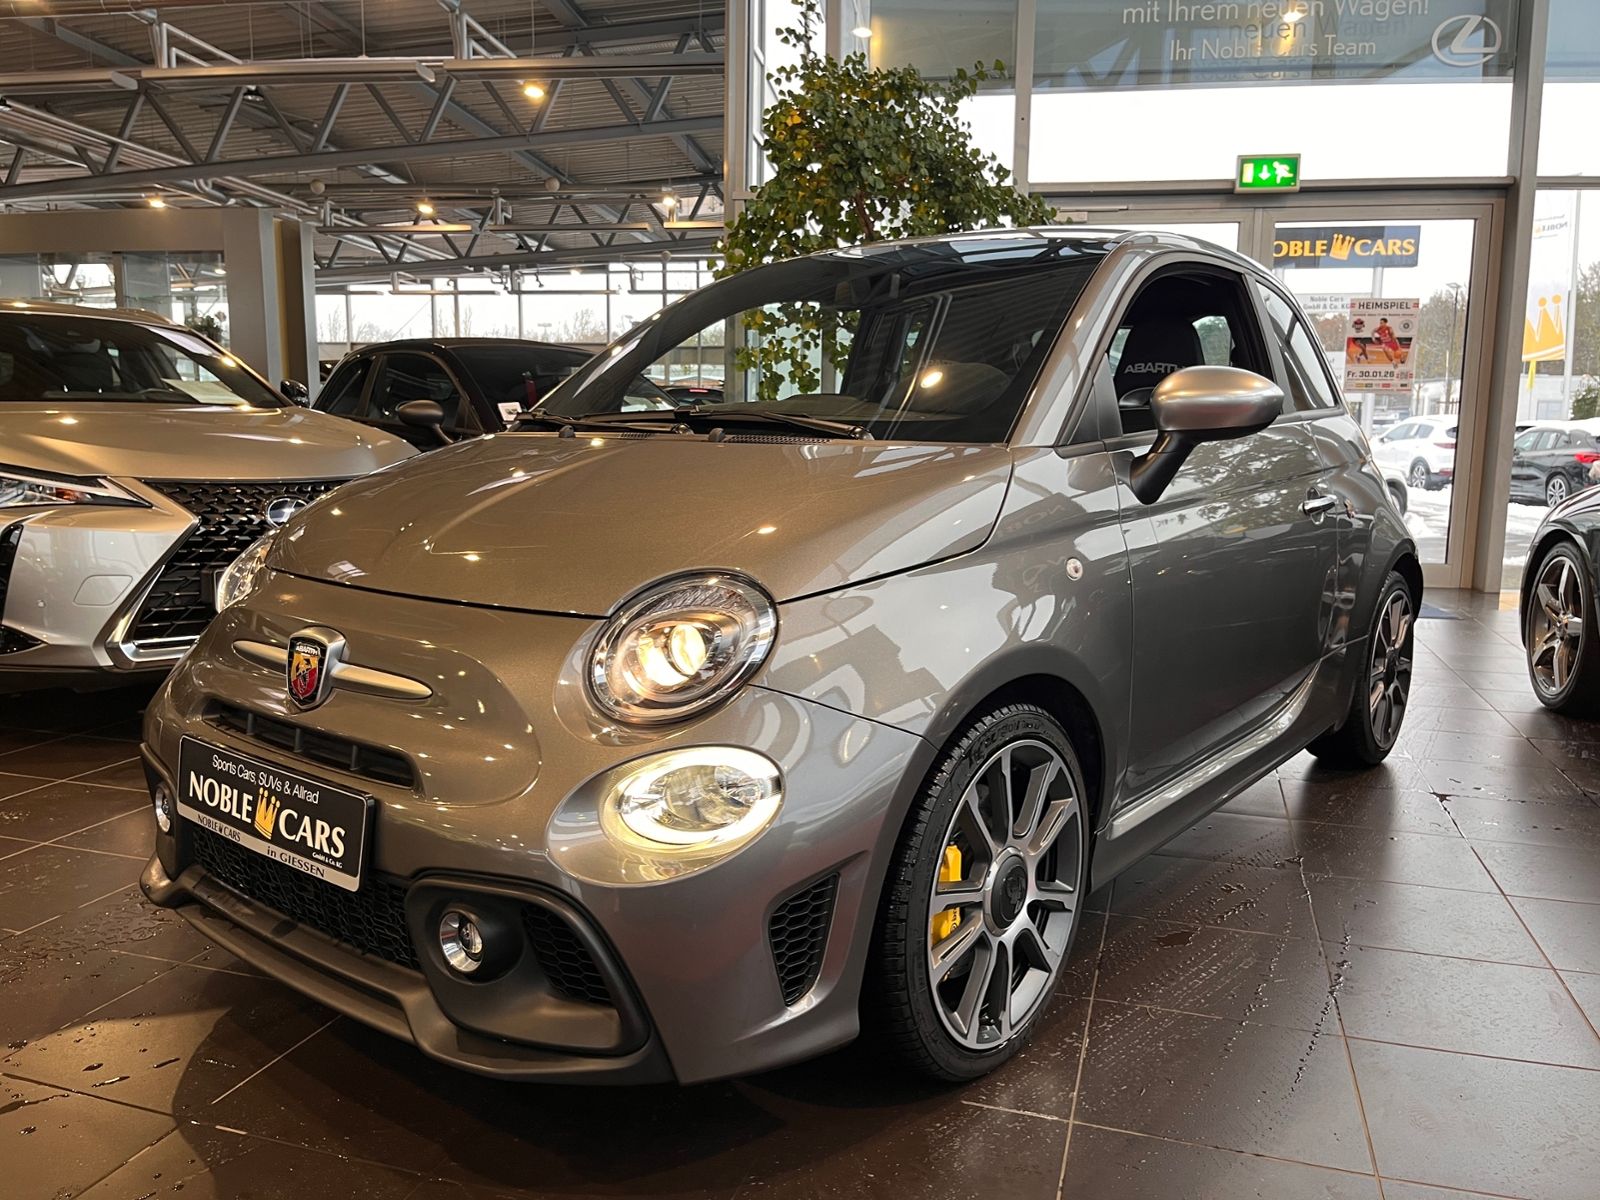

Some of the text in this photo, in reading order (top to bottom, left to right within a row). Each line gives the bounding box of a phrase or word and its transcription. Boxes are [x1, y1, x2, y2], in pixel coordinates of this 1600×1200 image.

[1122, 0, 1429, 24] mit Ihrem neuen Wagen!
[1170, 40, 1196, 61] Ihr
[1324, 34, 1376, 56] Team
[1272, 239, 1416, 257] OBLE CARS
[1358, 301, 1411, 310] HEIMSPIEL
[212, 754, 320, 805] Sports Cars, SUVs & Allrad
[189, 770, 346, 858] NOBLE CARS
[197, 814, 241, 843] NOBLE CARS
[266, 845, 326, 878] in GIESSEN
